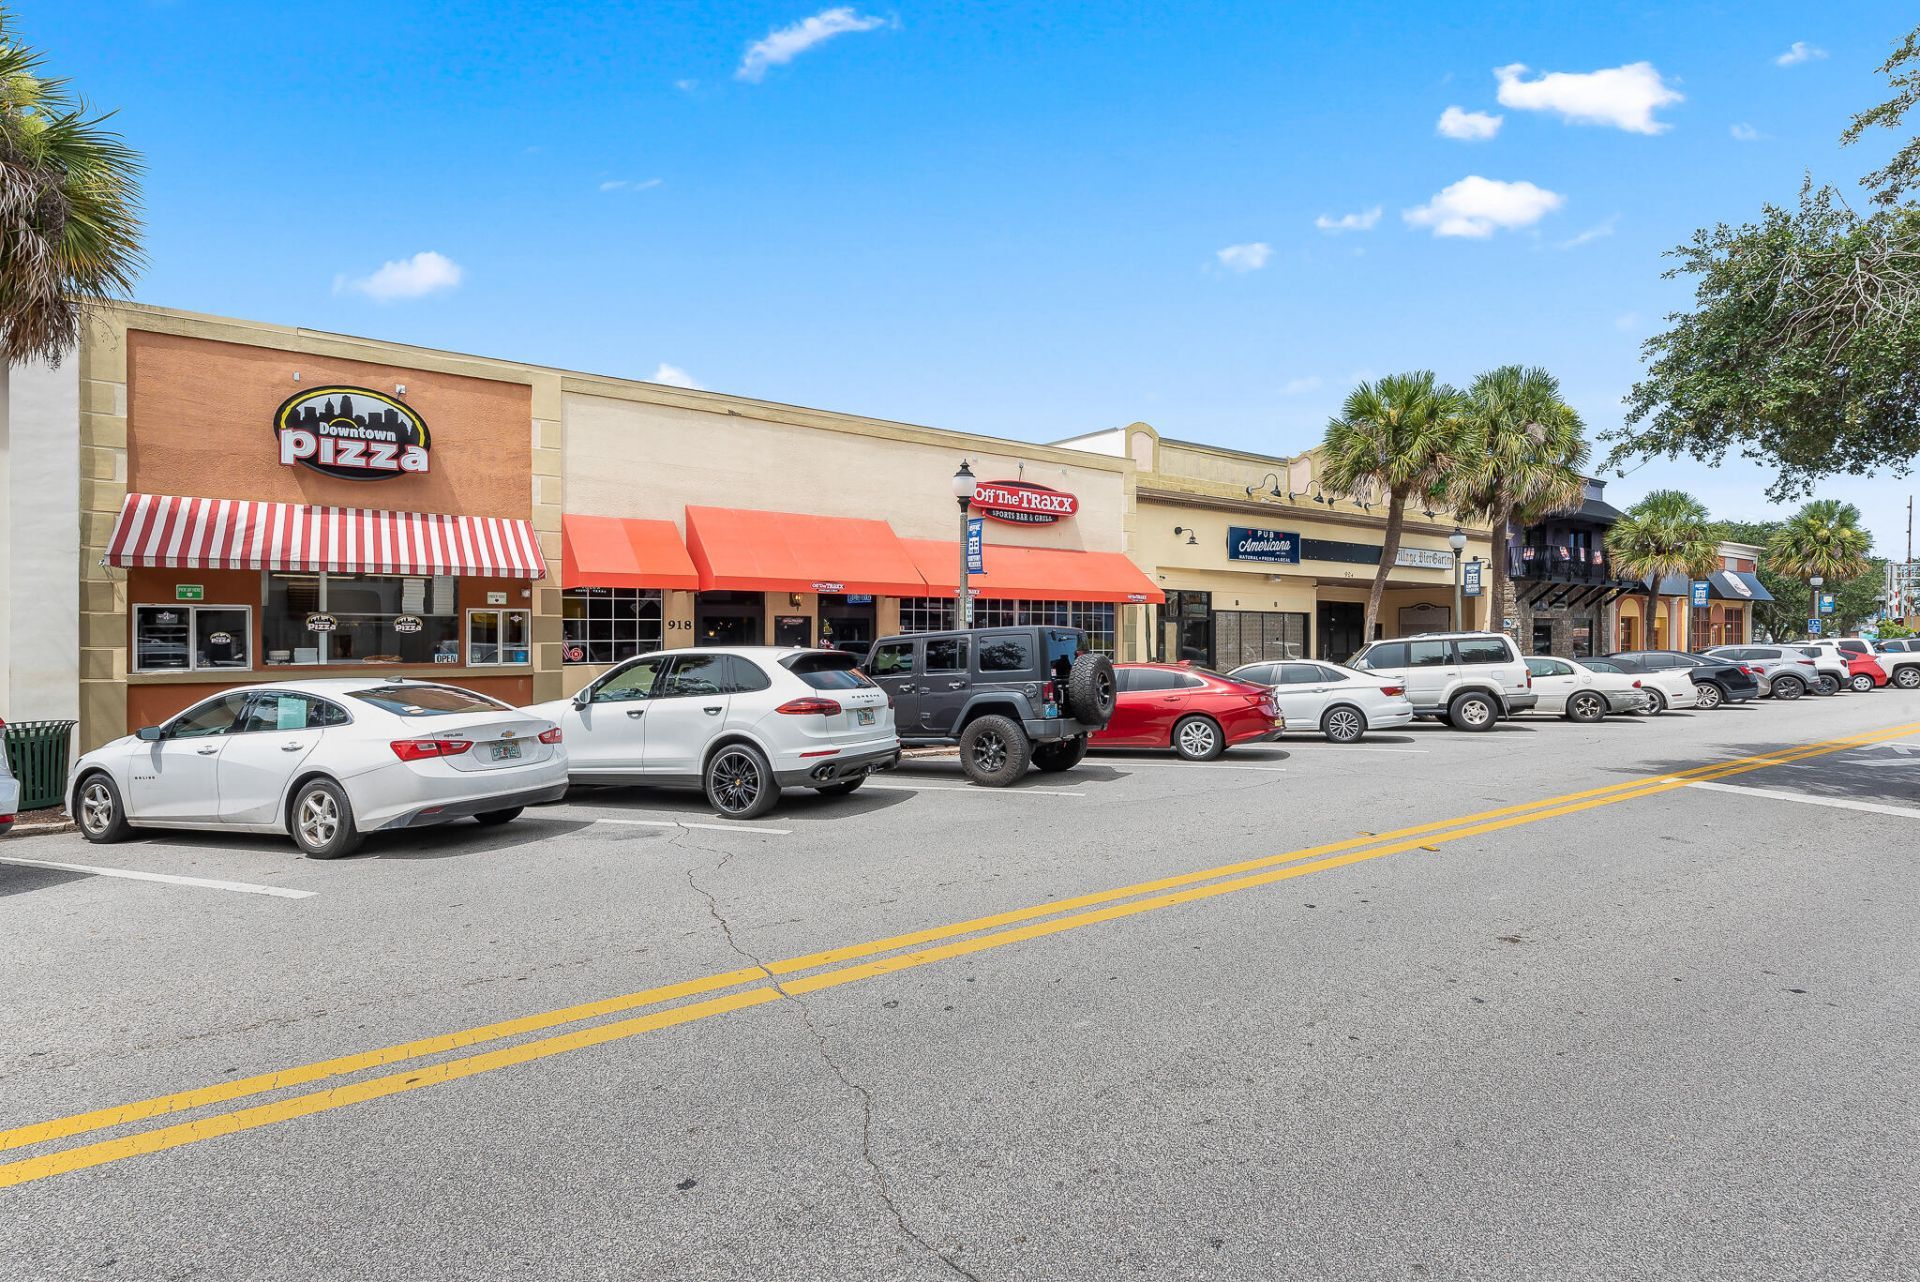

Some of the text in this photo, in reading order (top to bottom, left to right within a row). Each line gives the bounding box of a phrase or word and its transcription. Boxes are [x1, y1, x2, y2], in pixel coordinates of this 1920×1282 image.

[319, 421, 396, 442] Downtown
[974, 487, 995, 503] Off
[996, 490, 1019, 505] The
[992, 510, 1015, 521] SPORTS
[1016, 512, 1027, 521] BAR
[1035, 514, 1052, 522] GRILL
[1257, 530, 1274, 538] PUB
[1239, 538, 1291, 552] Americana
[1398, 549, 1416, 564] illage
[668, 620, 692, 630] 918
[437, 654, 457, 663] OPEN
